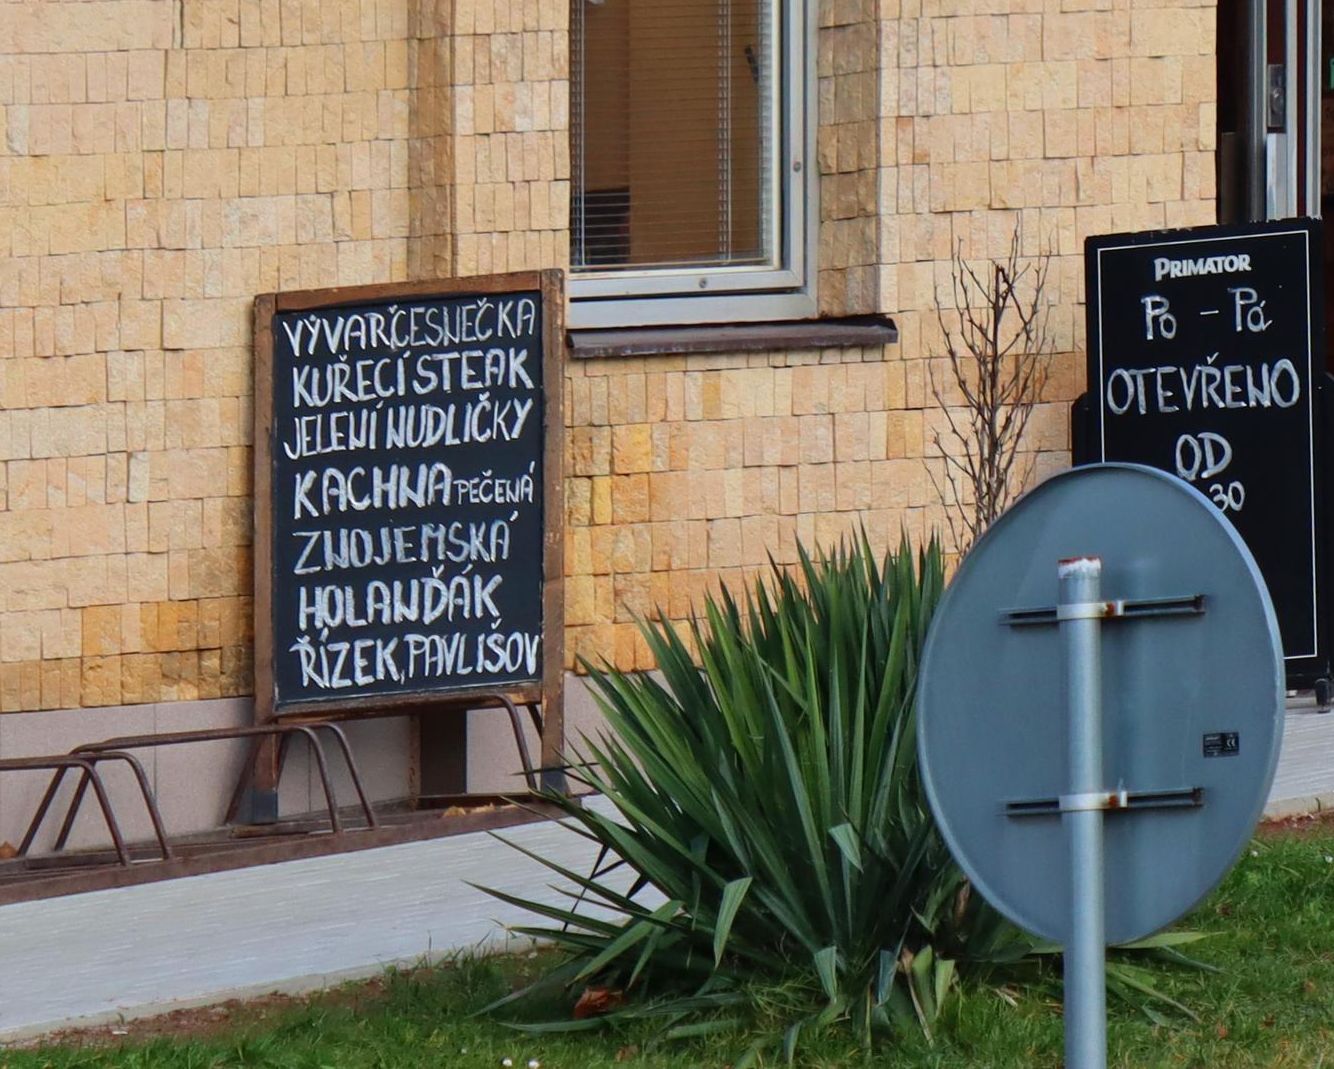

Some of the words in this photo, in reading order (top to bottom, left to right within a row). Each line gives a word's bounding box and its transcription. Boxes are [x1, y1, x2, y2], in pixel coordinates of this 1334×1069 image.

[1154, 254, 1251, 281] PRIMATOR
[389, 297, 536, 348] ČESNEČKA
[1141, 295, 1177, 340] Po
[1228, 287, 1273, 333] Pá
[292, 351, 410, 408] KUŘECÍ
[413, 347, 535, 395] STEAK
[1107, 352, 1300, 416] OTEVŘENO
[283, 401, 383, 460] JELENÍ
[386, 392, 533, 449] NUDLIČKY
[1175, 432, 1232, 481] OD
[294, 462, 453, 520] KACHNA
[453, 460, 536, 504] PEČENÁ
[292, 510, 518, 575] ZNOJEMSKÁ
[299, 564, 503, 631] HOLANĎÁK
